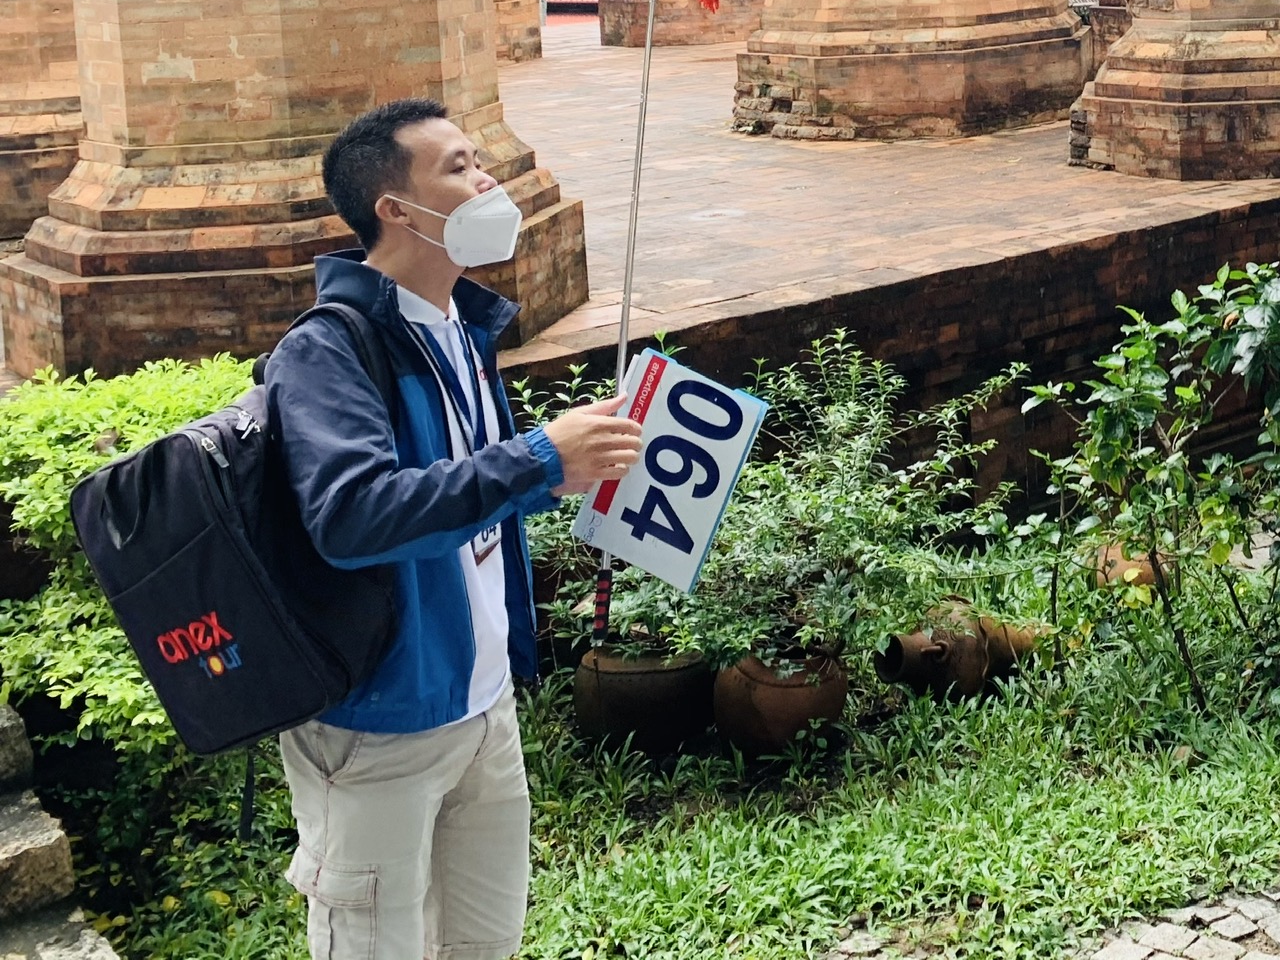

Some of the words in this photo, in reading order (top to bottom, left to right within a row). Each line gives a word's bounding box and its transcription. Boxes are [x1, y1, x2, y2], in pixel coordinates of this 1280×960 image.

[632, 362, 660, 421] anextour.co
[620, 379, 743, 555] 064
[157, 611, 233, 664] anex
[199, 643, 243, 679] tour
